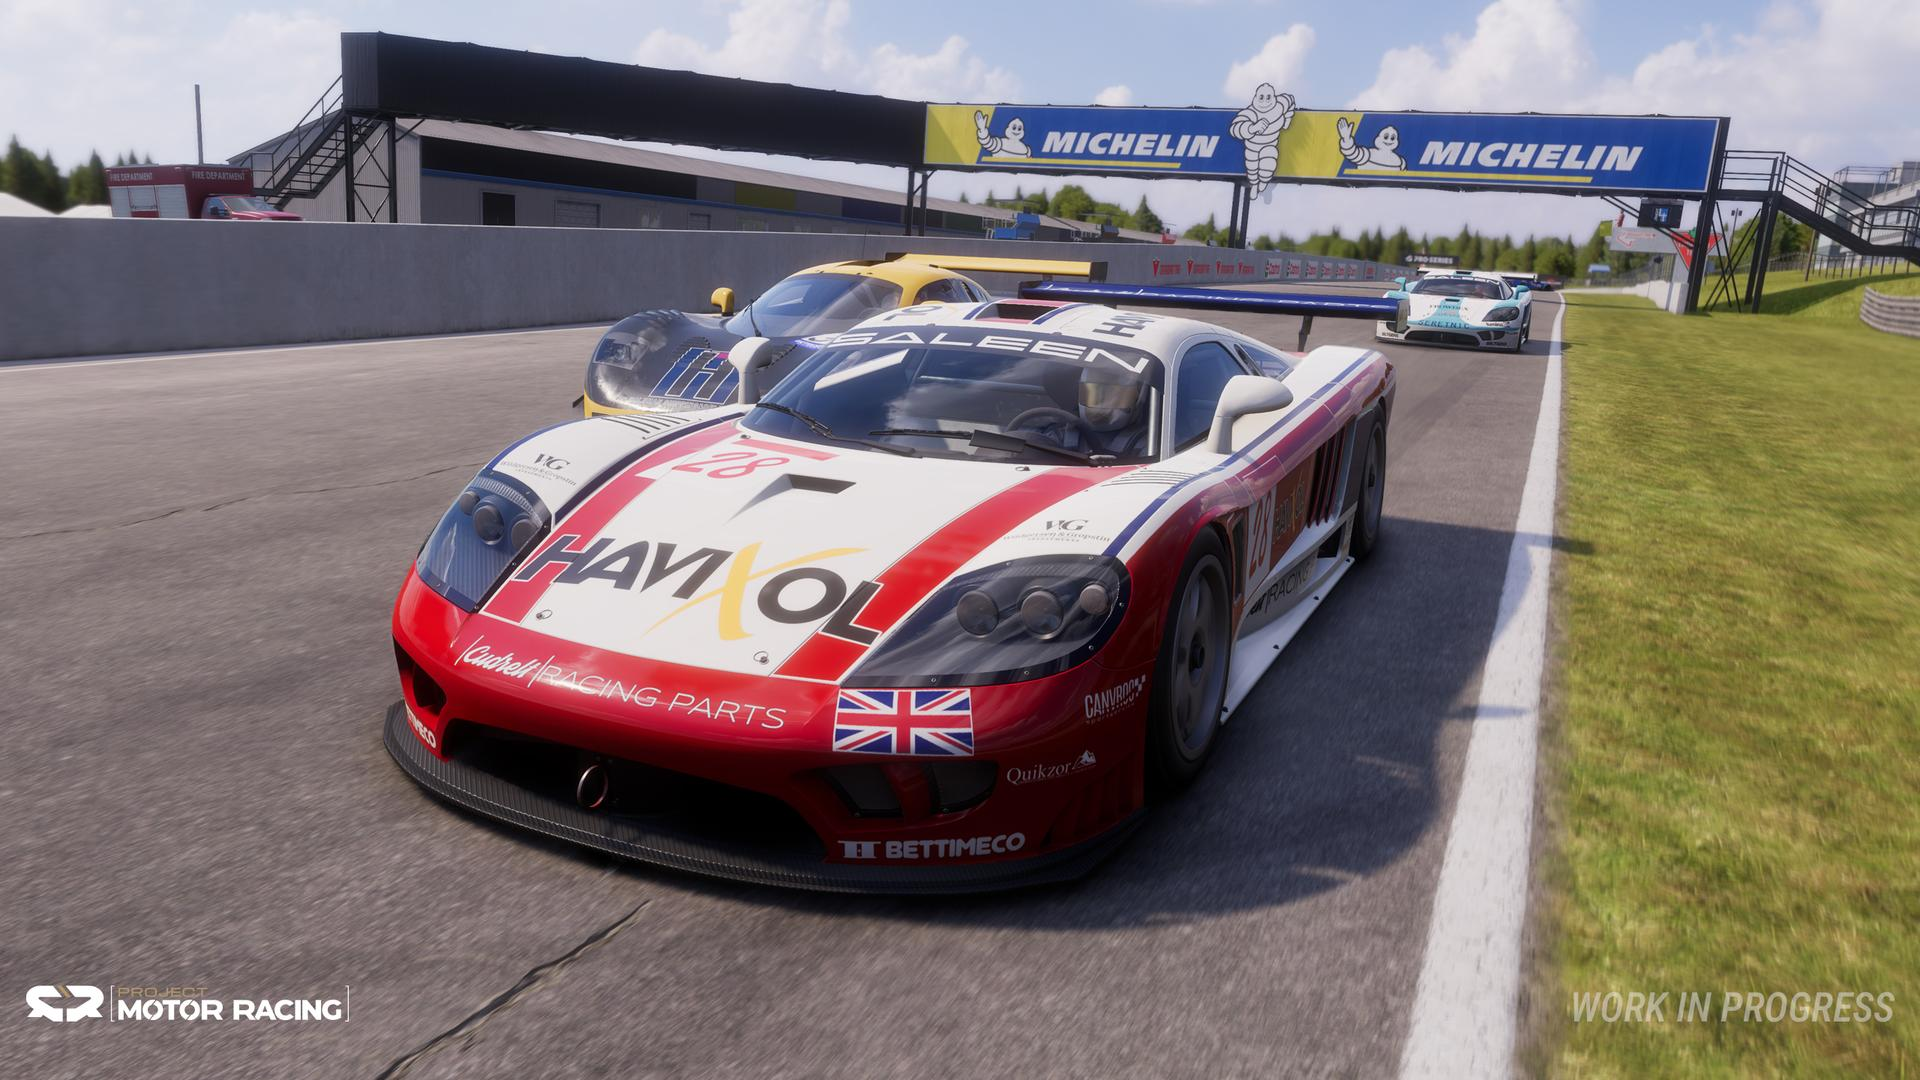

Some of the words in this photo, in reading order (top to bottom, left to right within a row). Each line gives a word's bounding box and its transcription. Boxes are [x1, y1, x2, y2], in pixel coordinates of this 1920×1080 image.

[1042, 131, 1220, 158] MICHELIN
[1419, 141, 1644, 171] MICHELIN
[109, 173, 121, 181] FIRE
[121, 172, 153, 181] DEPARTMENT
[192, 172, 205, 180] FIRE
[206, 171, 246, 181] DEPARTMENT
[827, 332, 1150, 374] SALEEN
[671, 451, 790, 480] 28
[536, 665, 661, 707] RACING
[668, 692, 787, 730] PARTS
[1006, 762, 1072, 786] Quikzor
[885, 832, 1026, 859] BETTIMECO
